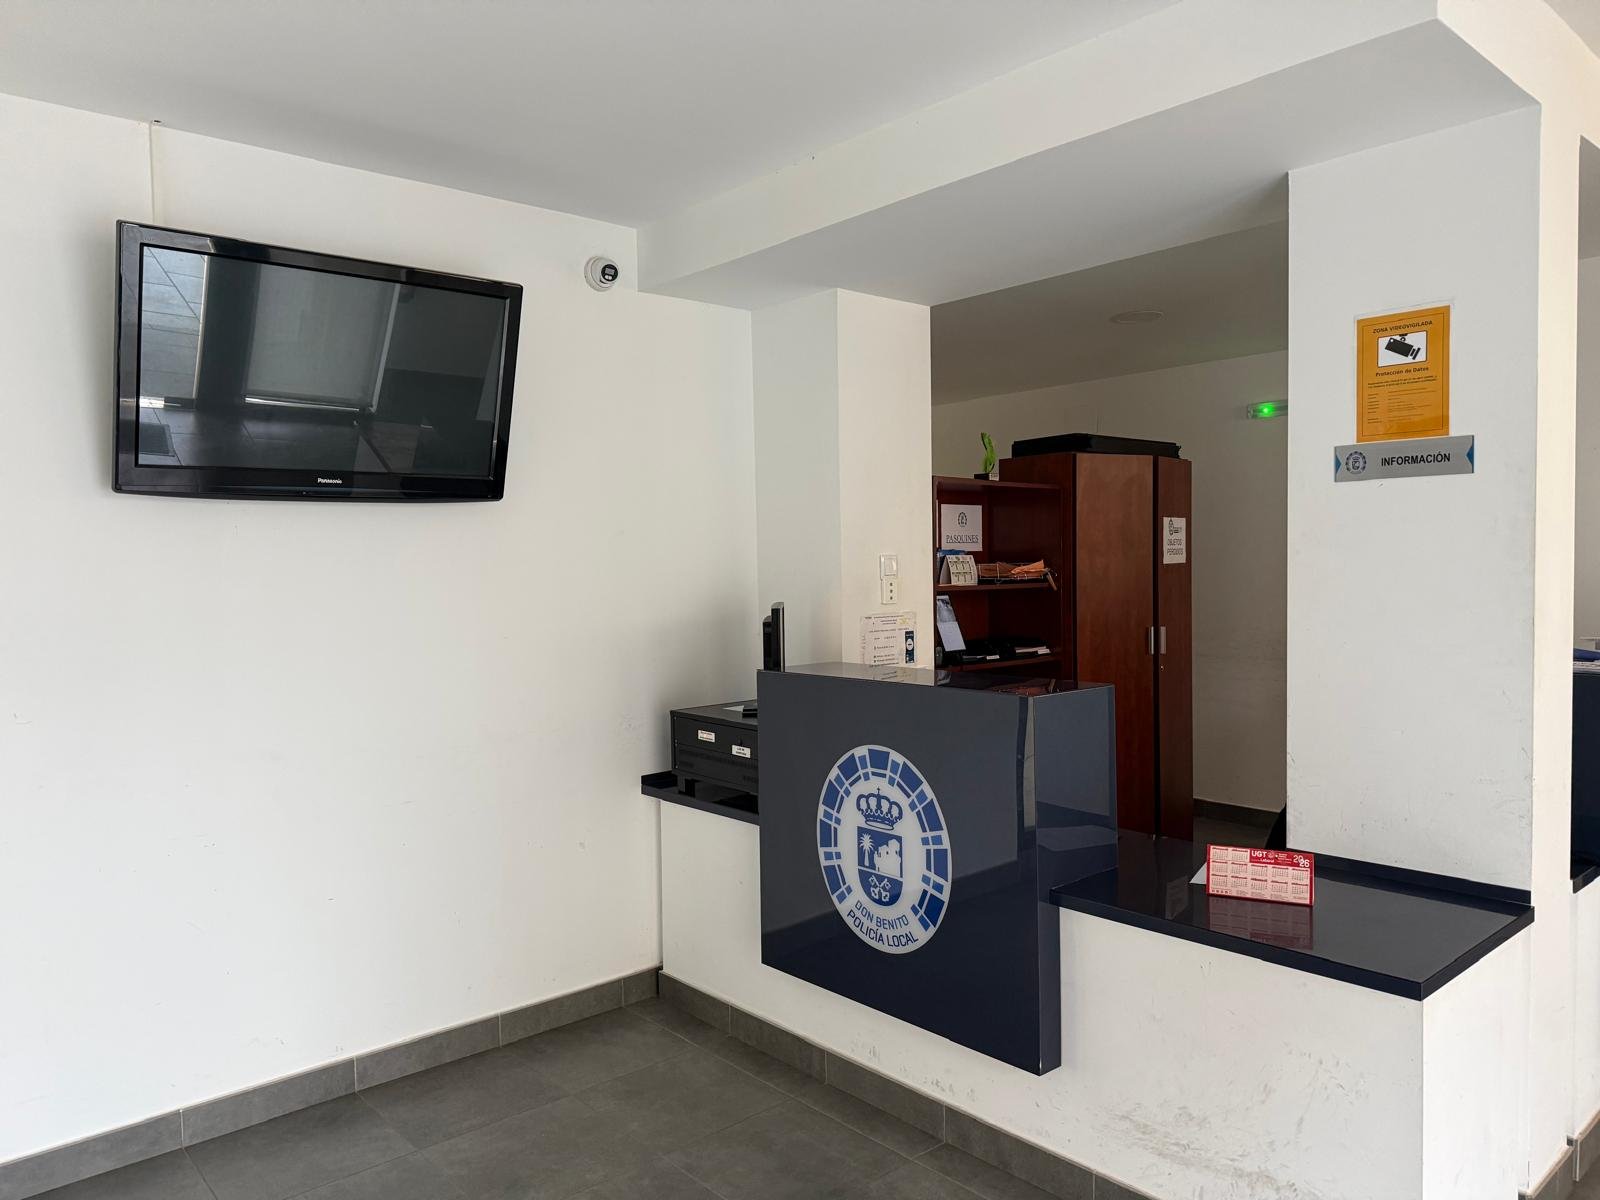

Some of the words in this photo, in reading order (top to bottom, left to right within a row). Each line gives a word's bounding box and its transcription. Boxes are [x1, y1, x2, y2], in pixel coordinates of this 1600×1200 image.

[1389, 320, 1433, 332] VIDEOVIGILADA
[1381, 452, 1451, 467] INFORMACIÓN
[945, 534, 979, 544] PASQUINES
[1251, 850, 1268, 858] UGT
[854, 899, 874, 924] DON
[875, 914, 909, 930] BENITO
[846, 909, 885, 945] POLICÍA
[887, 931, 919, 948] LOCAL
